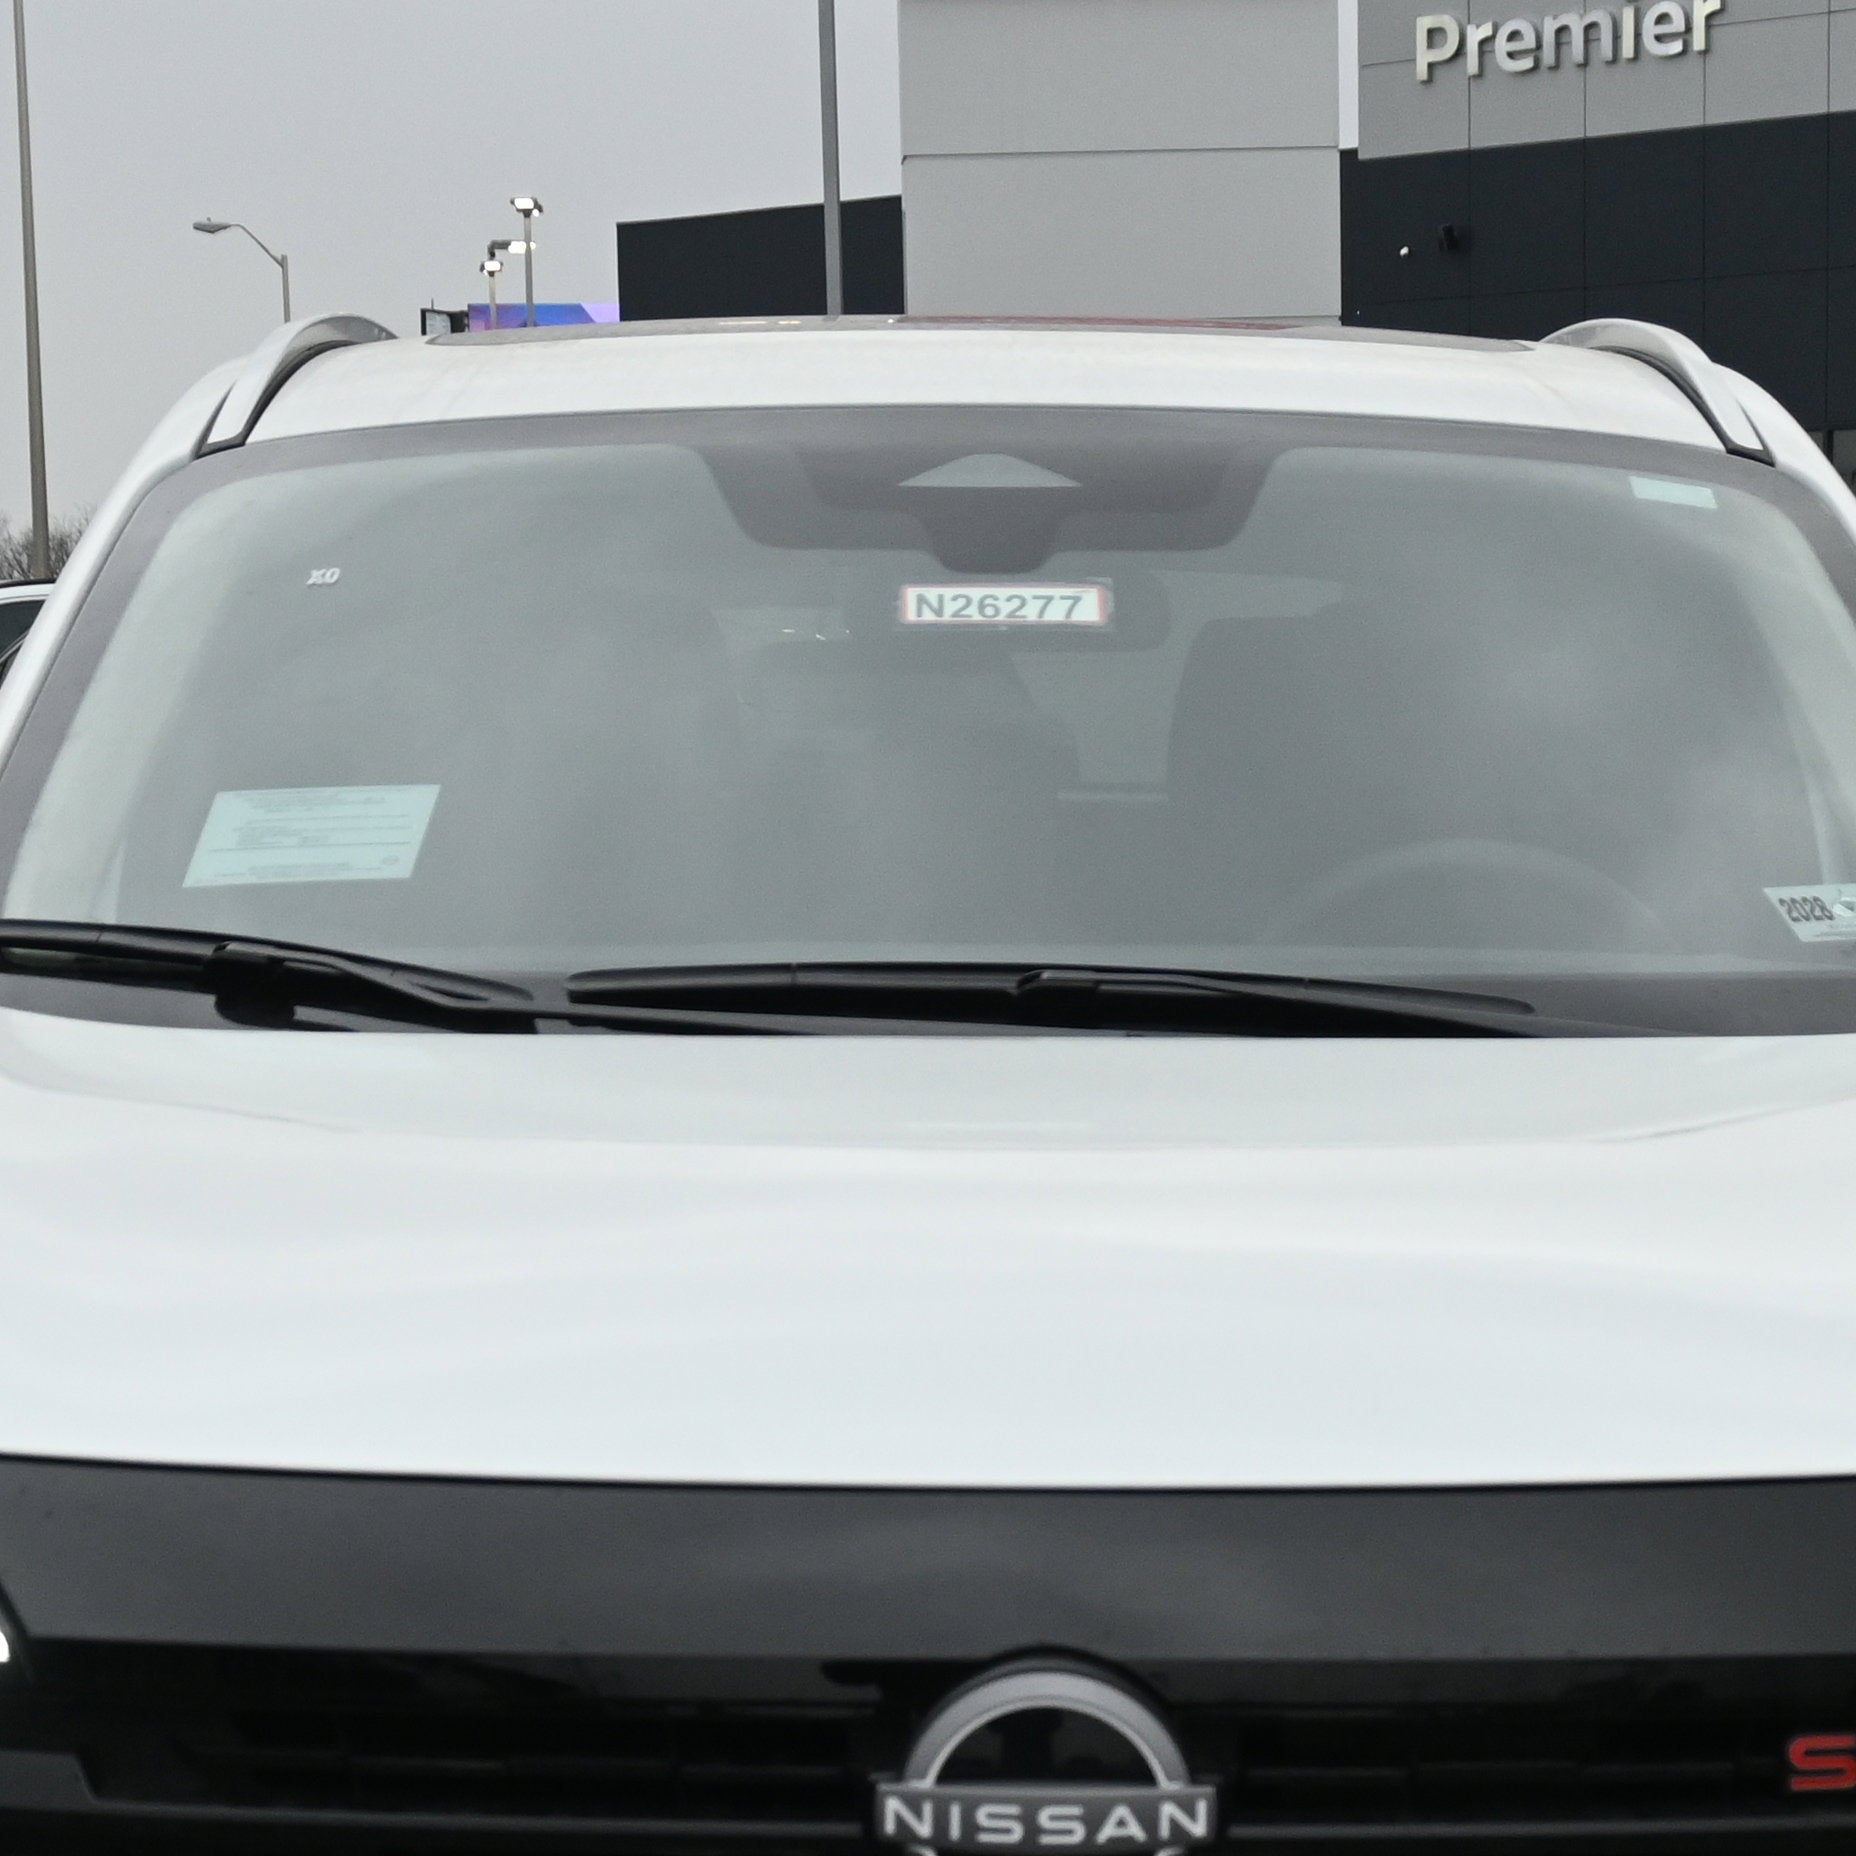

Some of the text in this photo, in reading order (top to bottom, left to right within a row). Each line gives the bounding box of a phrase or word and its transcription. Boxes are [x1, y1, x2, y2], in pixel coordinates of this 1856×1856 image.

[1415, 0, 1721, 81] Premier
[915, 592, 1083, 620] N26277
[1778, 895, 1835, 922] 2028
[882, 1794, 1208, 1847] NISSAN
